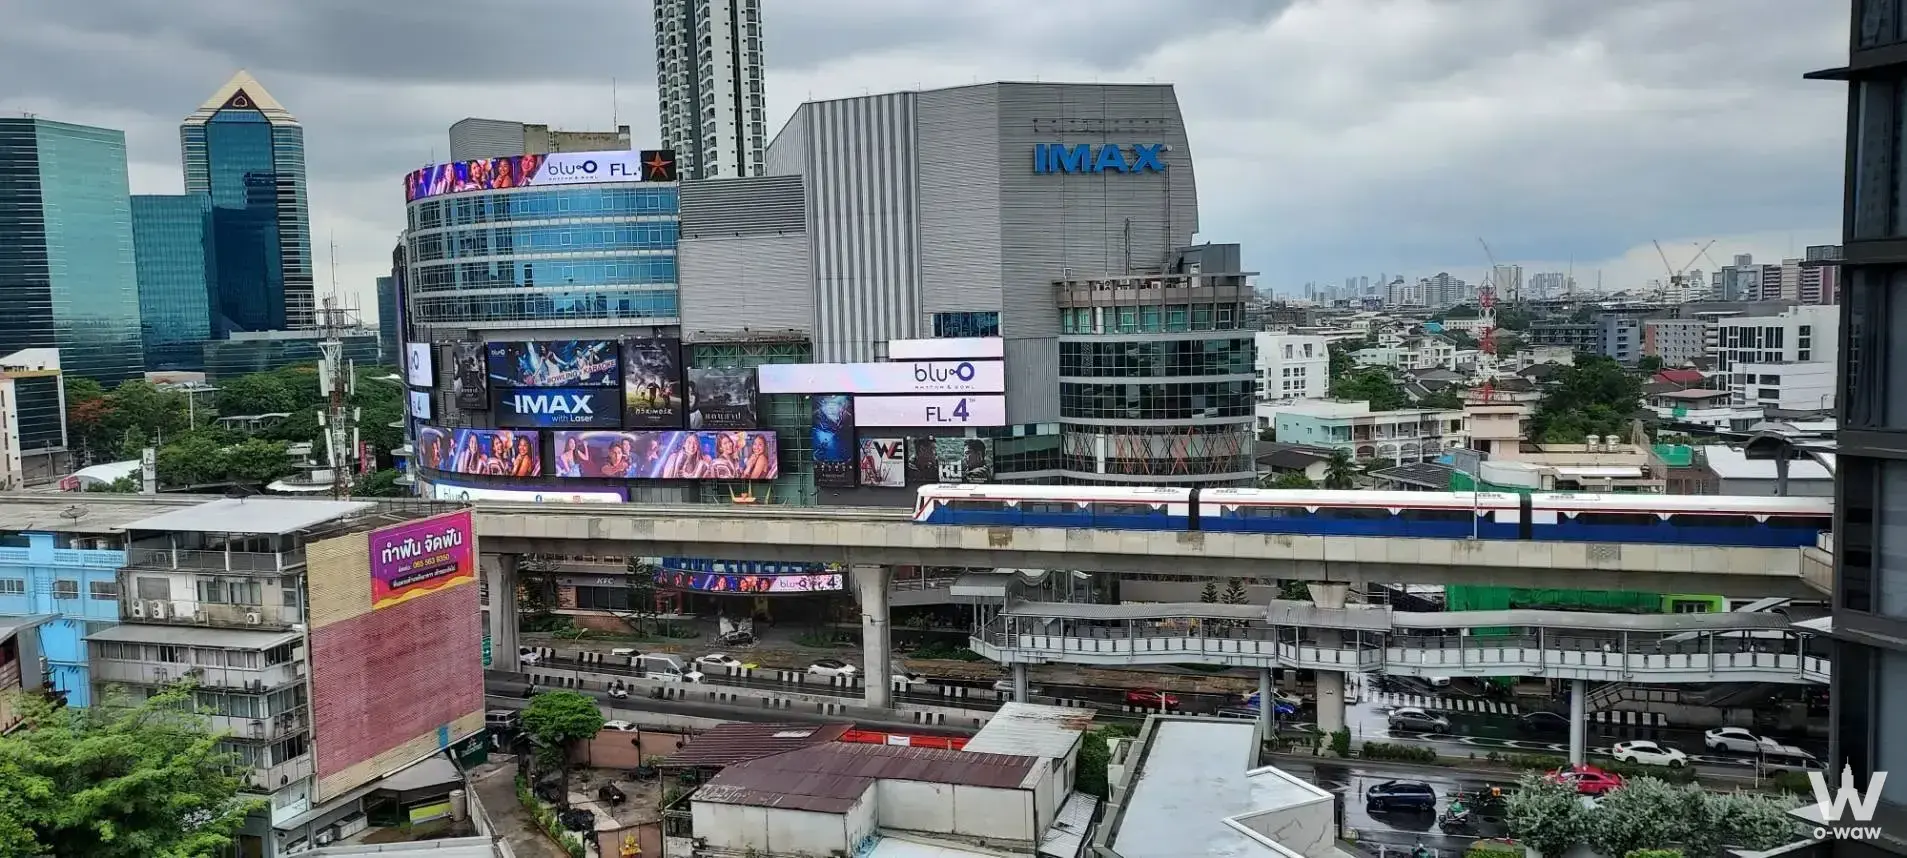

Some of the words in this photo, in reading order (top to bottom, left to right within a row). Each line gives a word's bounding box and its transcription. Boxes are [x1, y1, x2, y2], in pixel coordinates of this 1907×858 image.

[1034, 143, 1166, 174] IMAX
[514, 395, 594, 414] IMAX
[552, 415, 569, 423] with
[570, 415, 594, 423] Laser
[382, 538, 421, 564] ทำฟัน
[424, 528, 462, 553] จัดฟัน
